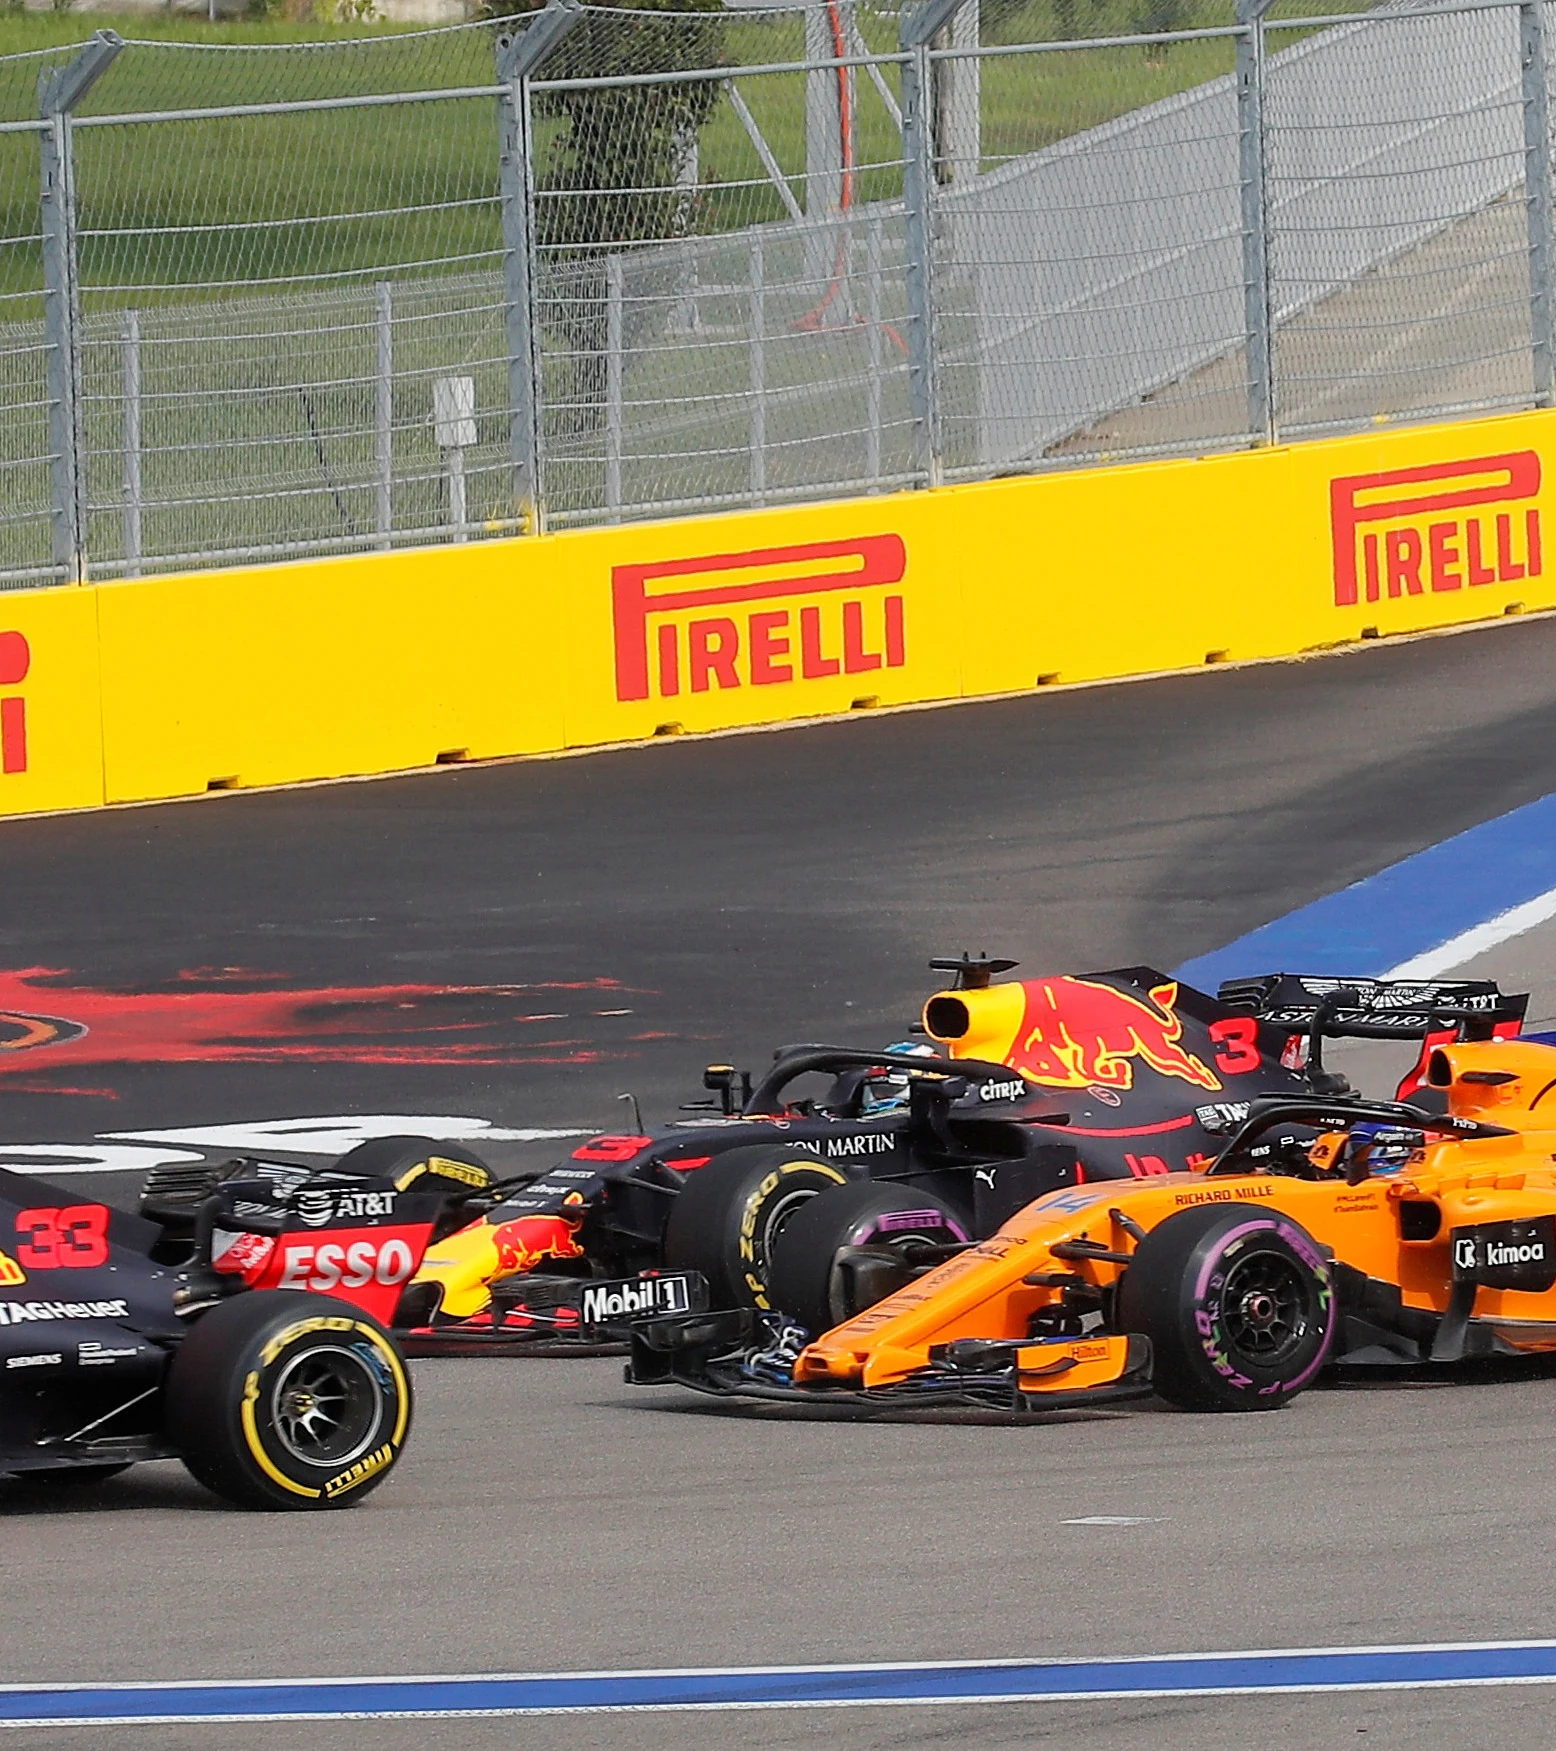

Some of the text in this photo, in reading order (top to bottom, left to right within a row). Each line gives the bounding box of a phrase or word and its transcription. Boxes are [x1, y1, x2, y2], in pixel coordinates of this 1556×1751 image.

[1330, 450, 1541, 606] PIRELLI
[612, 533, 907, 702] PIRELLI
[1208, 1016, 1262, 1075] 3
[827, 1133, 895, 1157] MARTIN
[336, 1191, 398, 1218] AT&T
[739, 1171, 780, 1263] ZERO
[1175, 1185, 1274, 1206] RICHARD MILLE
[15, 1203, 111, 1270] 33
[1487, 1242, 1545, 1266] kimoa
[277, 1239, 414, 1290] ESSO
[583, 1281, 654, 1324] Mobil
[324, 1444, 393, 1499] PIRELLI
